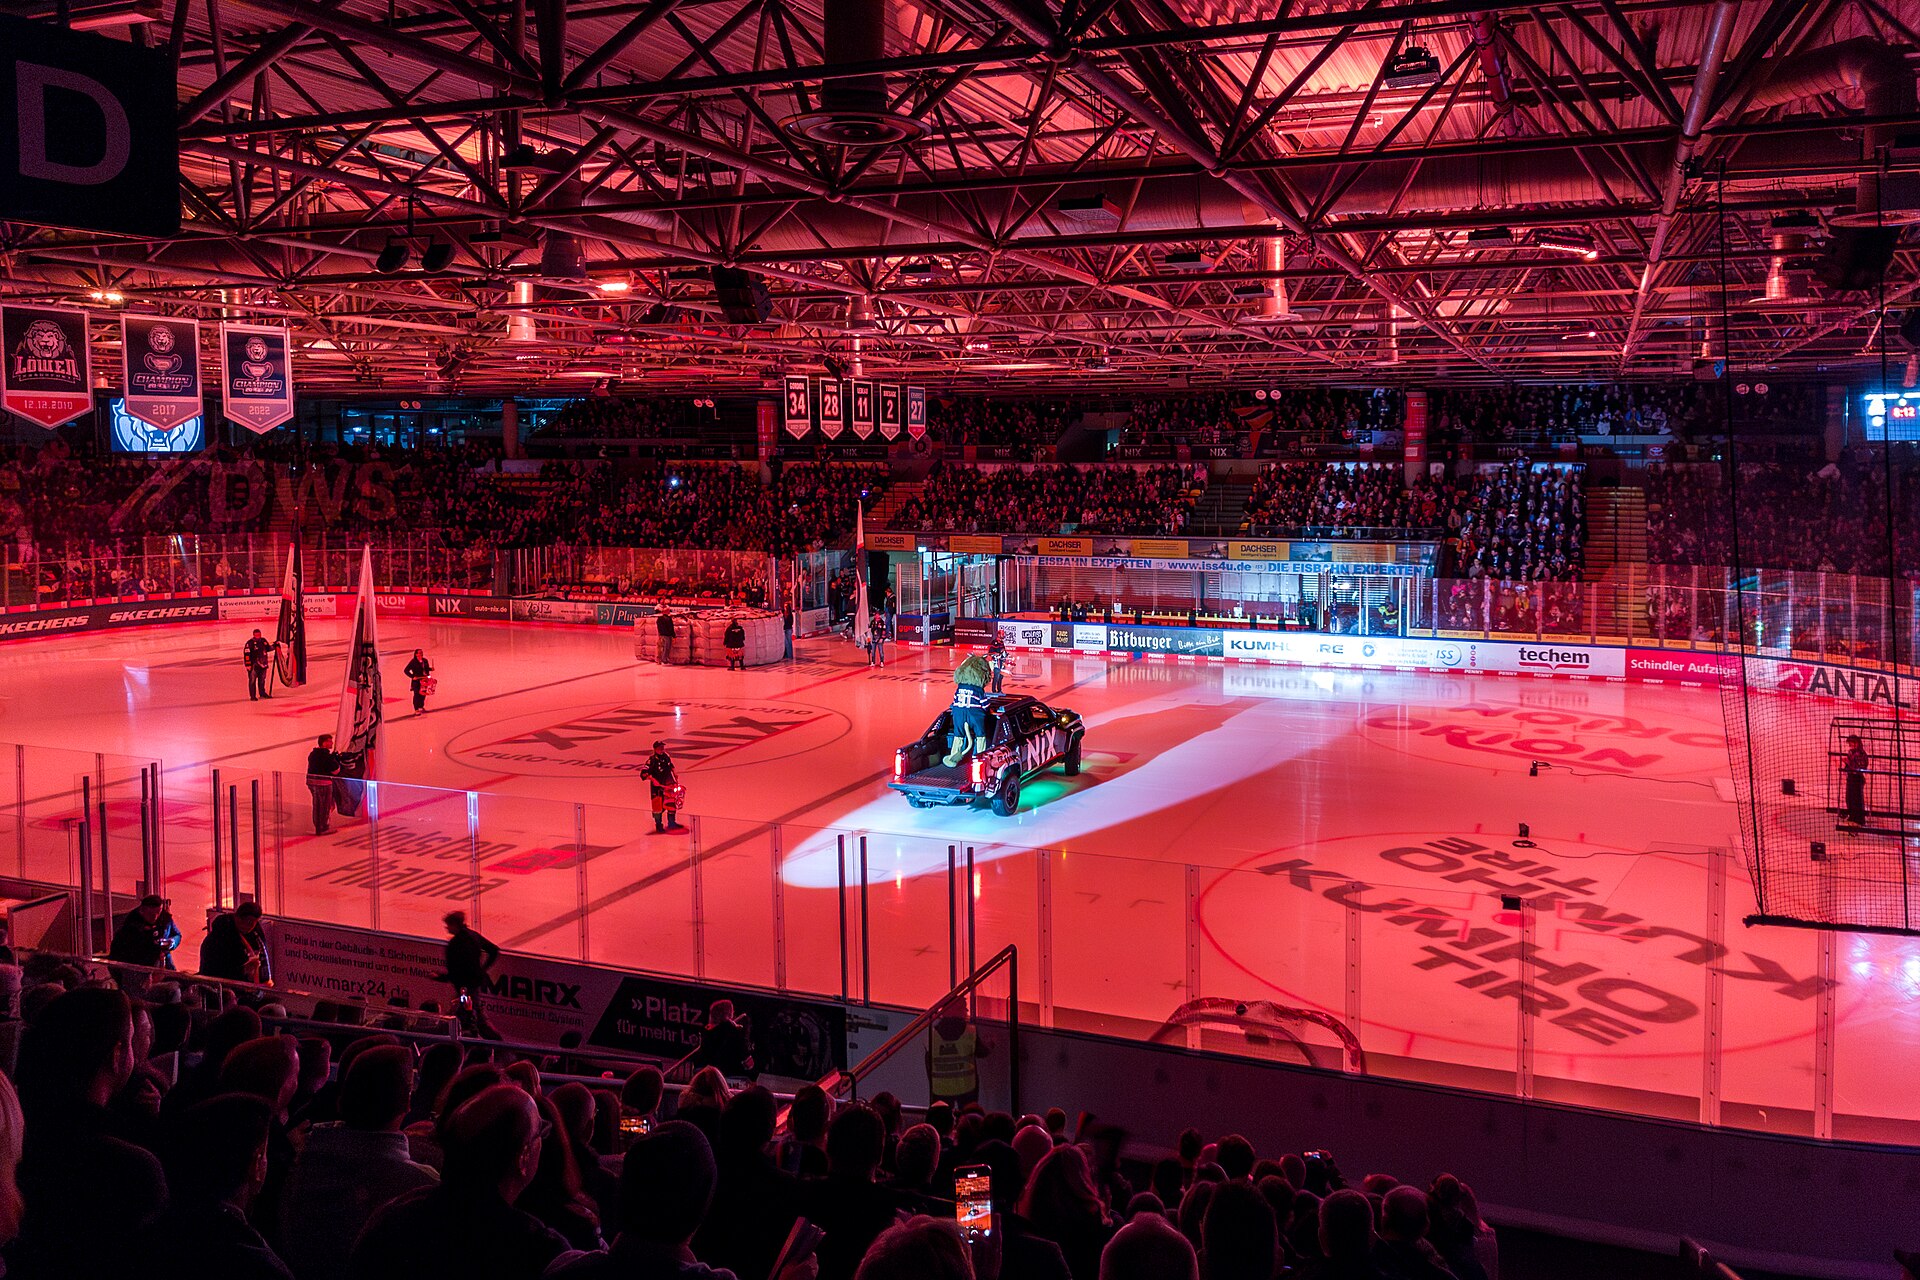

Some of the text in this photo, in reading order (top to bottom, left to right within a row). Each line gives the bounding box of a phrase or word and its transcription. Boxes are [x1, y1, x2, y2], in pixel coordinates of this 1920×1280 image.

[16, 60, 131, 186] D
[136, 375, 190, 384] CHAMPION
[235, 380, 281, 389] CHAMPION
[152, 404, 176, 415] 2017
[248, 405, 271, 415] 2022
[789, 391, 807, 416] 34
[823, 393, 839, 418] 28
[857, 396, 868, 418] 11
[886, 399, 894, 419] 2
[910, 400, 924, 421] 27
[994, 448, 1011, 457] NIX
[1124, 448, 1141, 457] NIX
[1209, 447, 1227, 457] NIX
[874, 536, 905, 545] DACHSER
[1048, 540, 1082, 549] DACHSER
[1240, 544, 1277, 553] DACHSER
[1038, 557, 1088, 567] EISBAHN
[1091, 558, 1152, 569] EXPERTEN
[1168, 561, 1252, 572] www.iss4u.de
[1268, 562, 1289, 573] DIE
[1353, 564, 1423, 576] EXPERTEN
[373, 595, 406, 609] RION
[435, 599, 461, 613] NIX
[475, 604, 508, 613] auto-nix.de
[108, 605, 214, 624] SKECHERS
[617, 609, 638, 622] Plus
[1108, 629, 1173, 650] Bitburger
[1518, 646, 1590, 665] techem
[1630, 659, 1685, 673] Schindler
[1025, 726, 1058, 771] NIX
[1363, 715, 1665, 773] ORION
[1424, 836, 1600, 897] TIRE
[303, 858, 511, 901] Pharma
[1378, 846, 1842, 1000] KUMHO
[1254, 858, 1700, 1024] KUMHO
[284, 948, 300, 959] und
[353, 957, 374, 970] rund
[375, 963, 389, 973] um
[391, 964, 408, 975] den
[479, 973, 583, 1010] MARX
[1412, 944, 1649, 1046] TIRE
[616, 1018, 637, 1036] für
[639, 1025, 678, 1043] mehr
